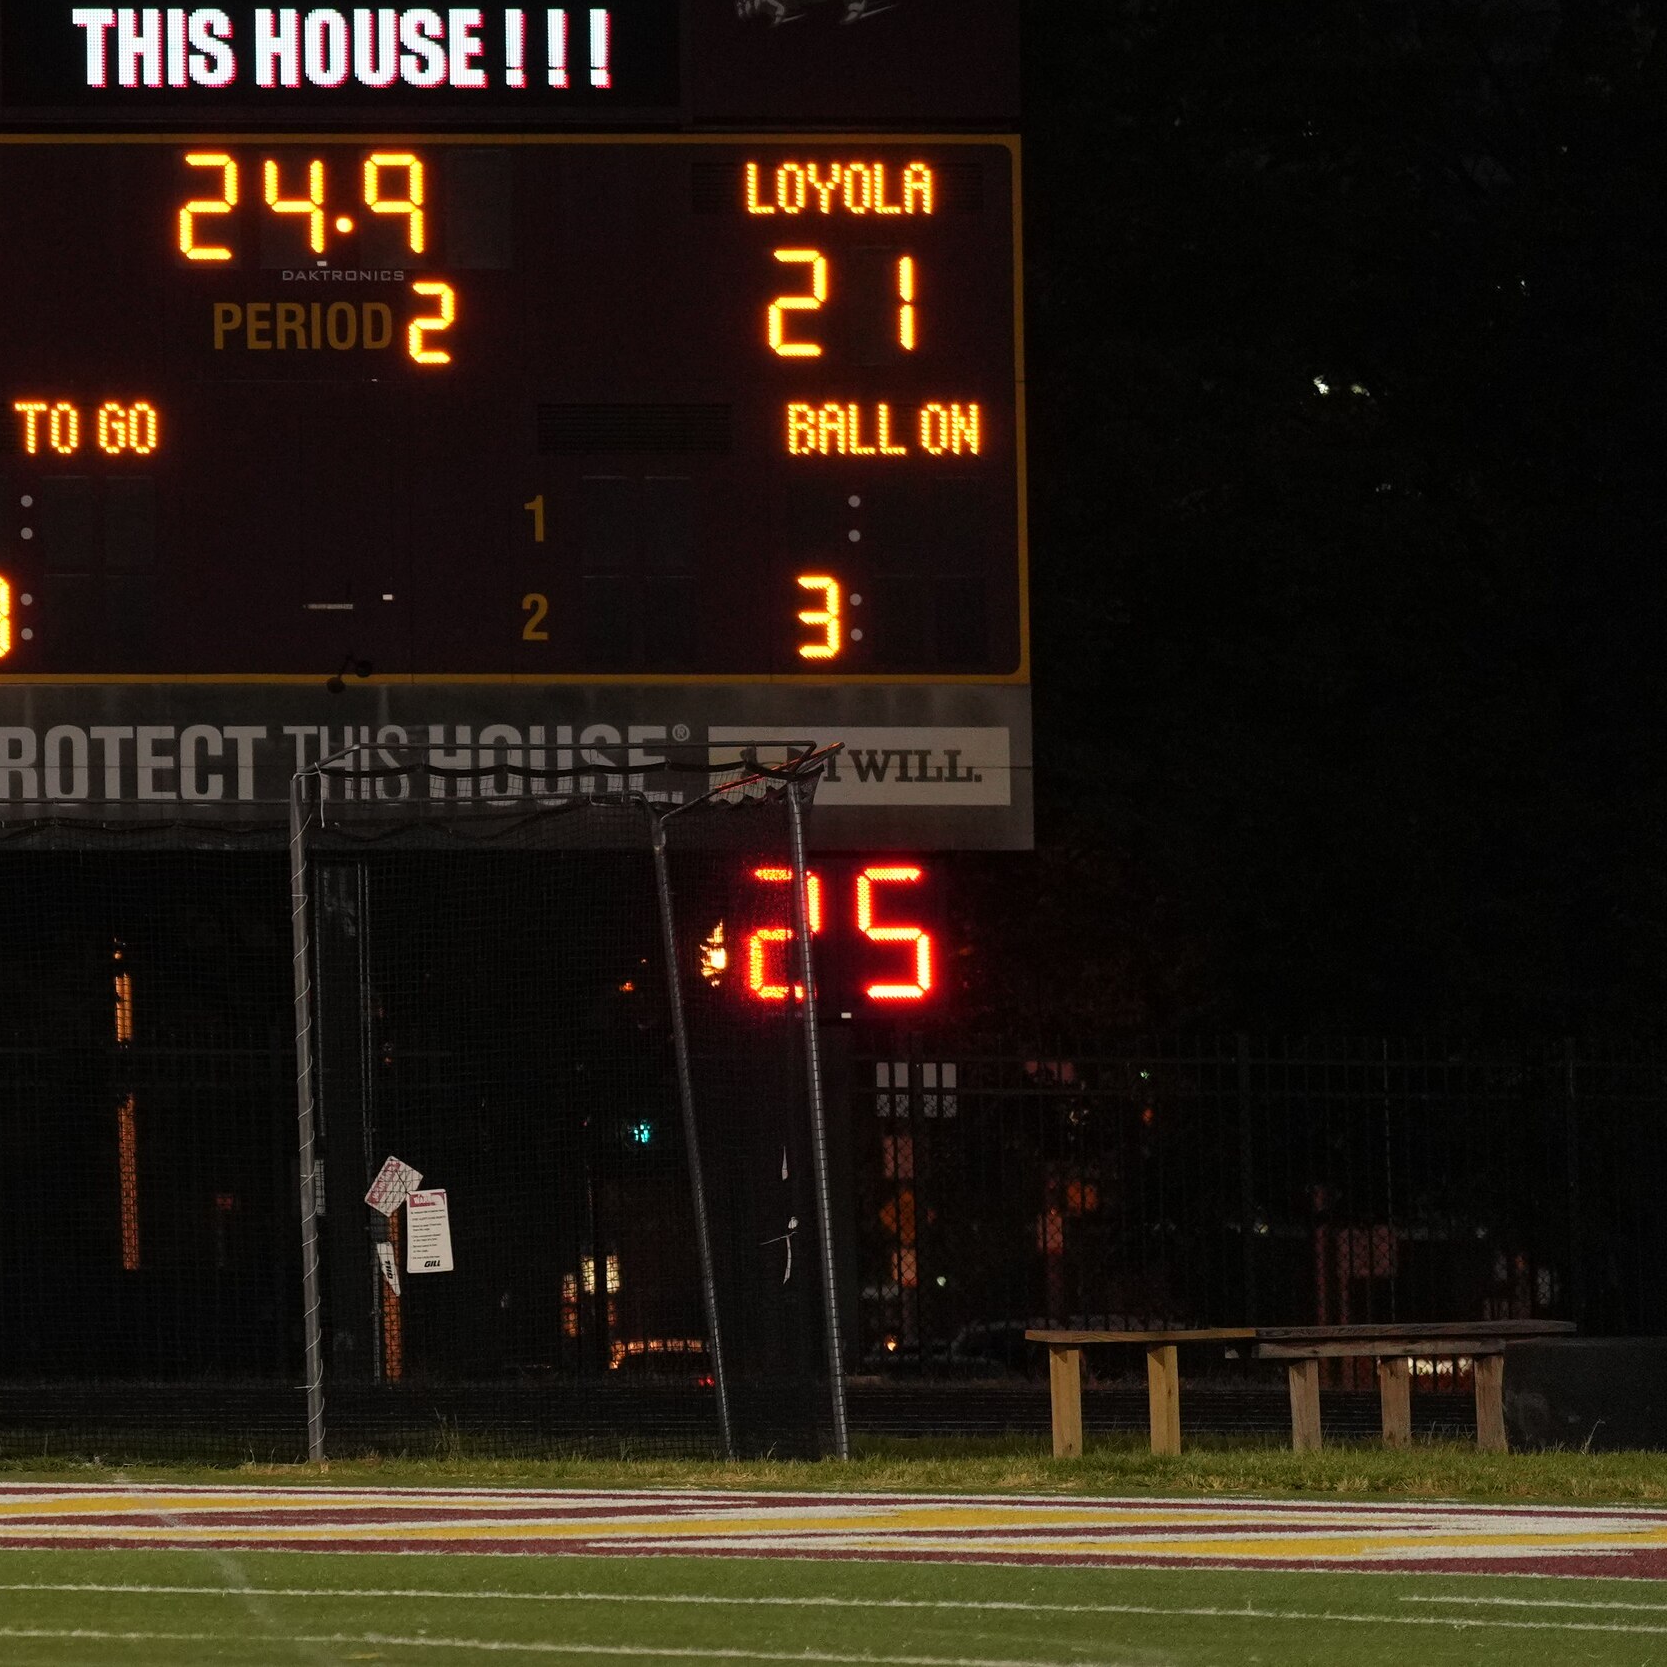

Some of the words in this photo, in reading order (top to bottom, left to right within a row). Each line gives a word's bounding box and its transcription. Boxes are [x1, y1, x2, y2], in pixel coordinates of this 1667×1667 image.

[72, 8, 238, 88] THIS
[179, 153, 426, 262] 24.9
[744, 161, 935, 216] LOYOLA
[282, 270, 405, 281] DAKTRONICS
[213, 301, 393, 351] PERIOD
[408, 282, 455, 365] 2
[767, 248, 918, 358] 21
[13, 402, 81, 456] TO
[97, 402, 160, 456] GO
[786, 402, 908, 456] BALL
[919, 402, 982, 456] ON
[524, 494, 545, 542] 1
[522, 593, 549, 641] 2
[282, 724, 411, 806] THIS
[848, 749, 983, 783] WILL.
[747, 865, 933, 1002] 25
[424, 1260, 441, 1268] GILL
